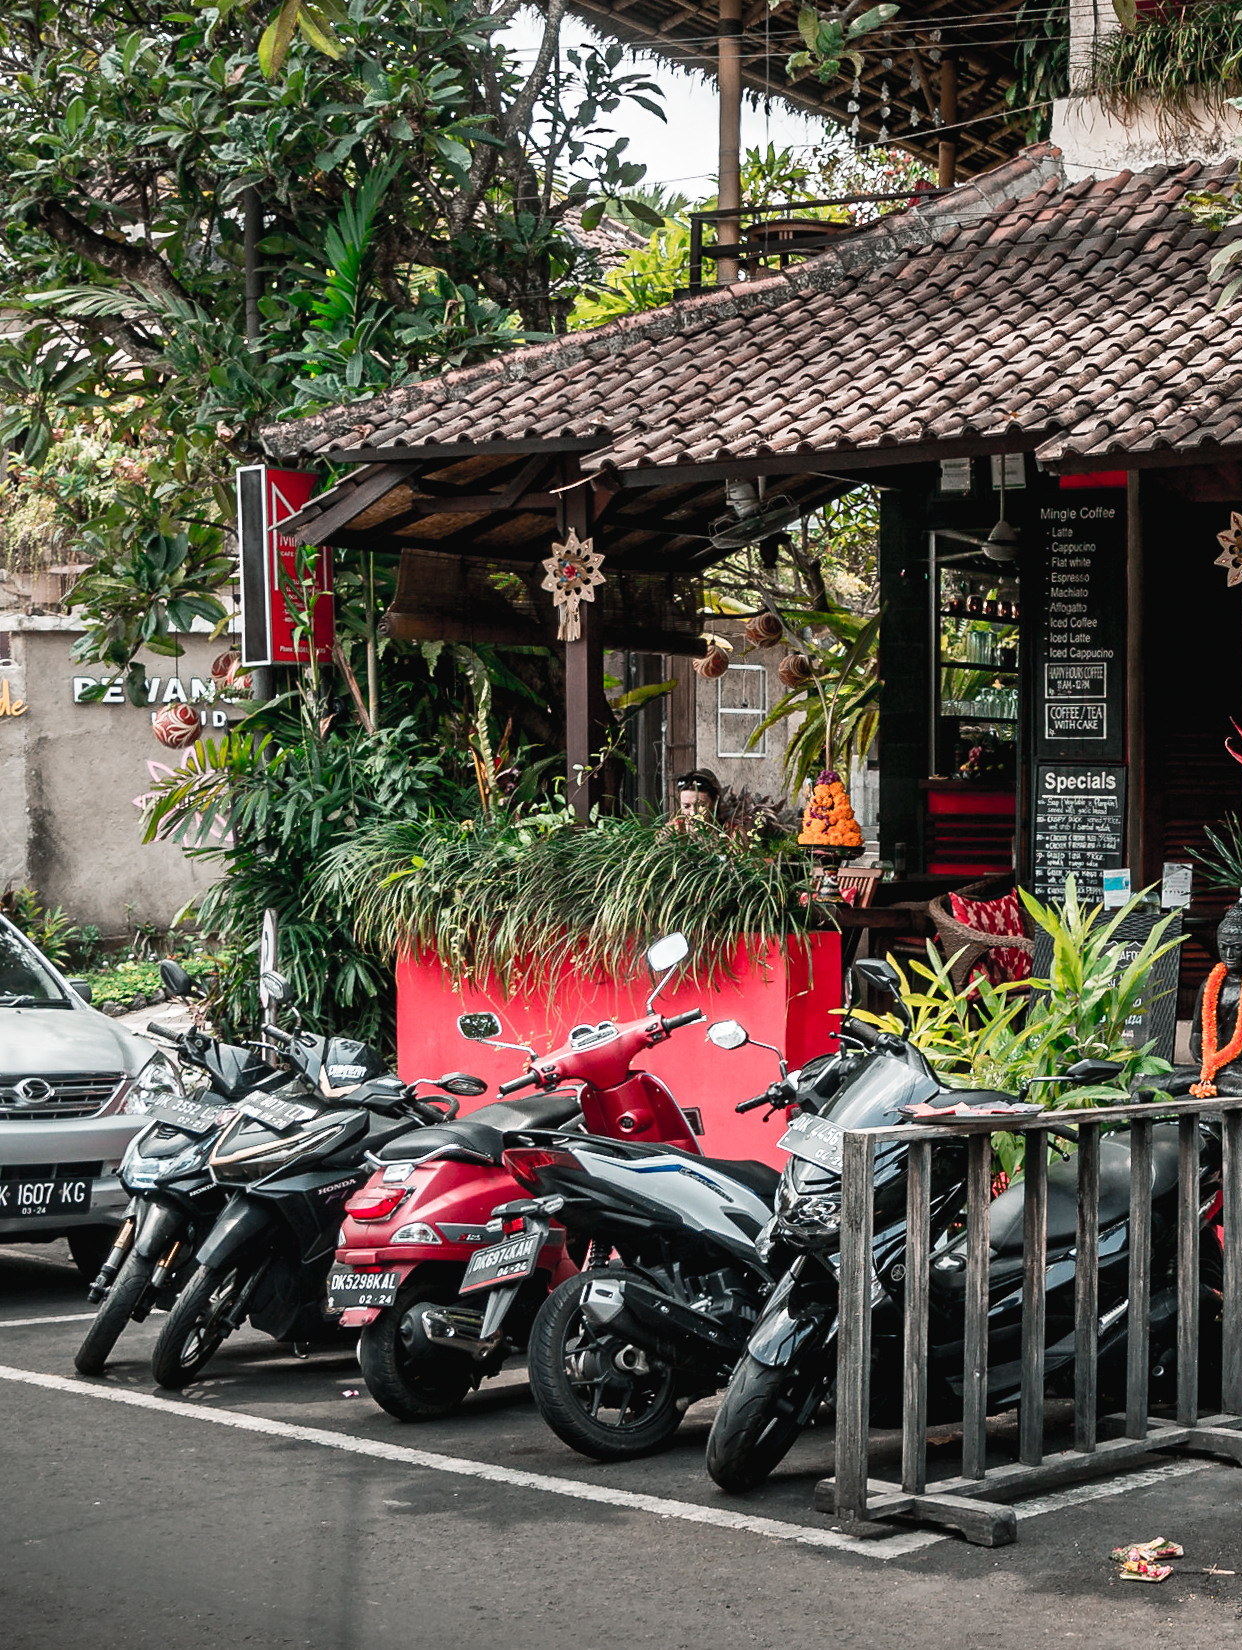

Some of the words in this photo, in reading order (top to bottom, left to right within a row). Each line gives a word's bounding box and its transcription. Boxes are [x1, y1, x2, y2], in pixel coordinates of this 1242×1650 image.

[1040, 508, 1076, 522] Mingle
[1080, 507, 1115, 519] Coffee
[1052, 527, 1073, 537] Latte
[1051, 541, 1096, 554] Cappucino
[1051, 556, 1067, 567] Flat
[1069, 556, 1091, 567] white
[1051, 572, 1090, 584] Espresso
[1050, 587, 1089, 597] Machiato
[1050, 617, 1068, 628] Iced
[1070, 617, 1098, 628] Coffee
[1049, 632, 1068, 643] Iced
[1069, 632, 1091, 643] Latte
[1049, 647, 1068, 658] Iced
[1069, 647, 1114, 660] Cappucino
[1066, 667, 1084, 679] HOURS
[1084, 667, 1104, 679] COFFEE
[1050, 707, 1080, 720] COFFEE
[1087, 707, 1103, 719] TEA
[1054, 720, 1076, 729] WITH
[1076, 720, 1099, 730] CAKE
[1044, 771, 1117, 793] Specials
[189, 1182, 218, 1197] HONDA
[318, 1179, 357, 1195] HONDA
[17, 1183, 55, 1205] 1607
[61, 1182, 86, 1203] KG
